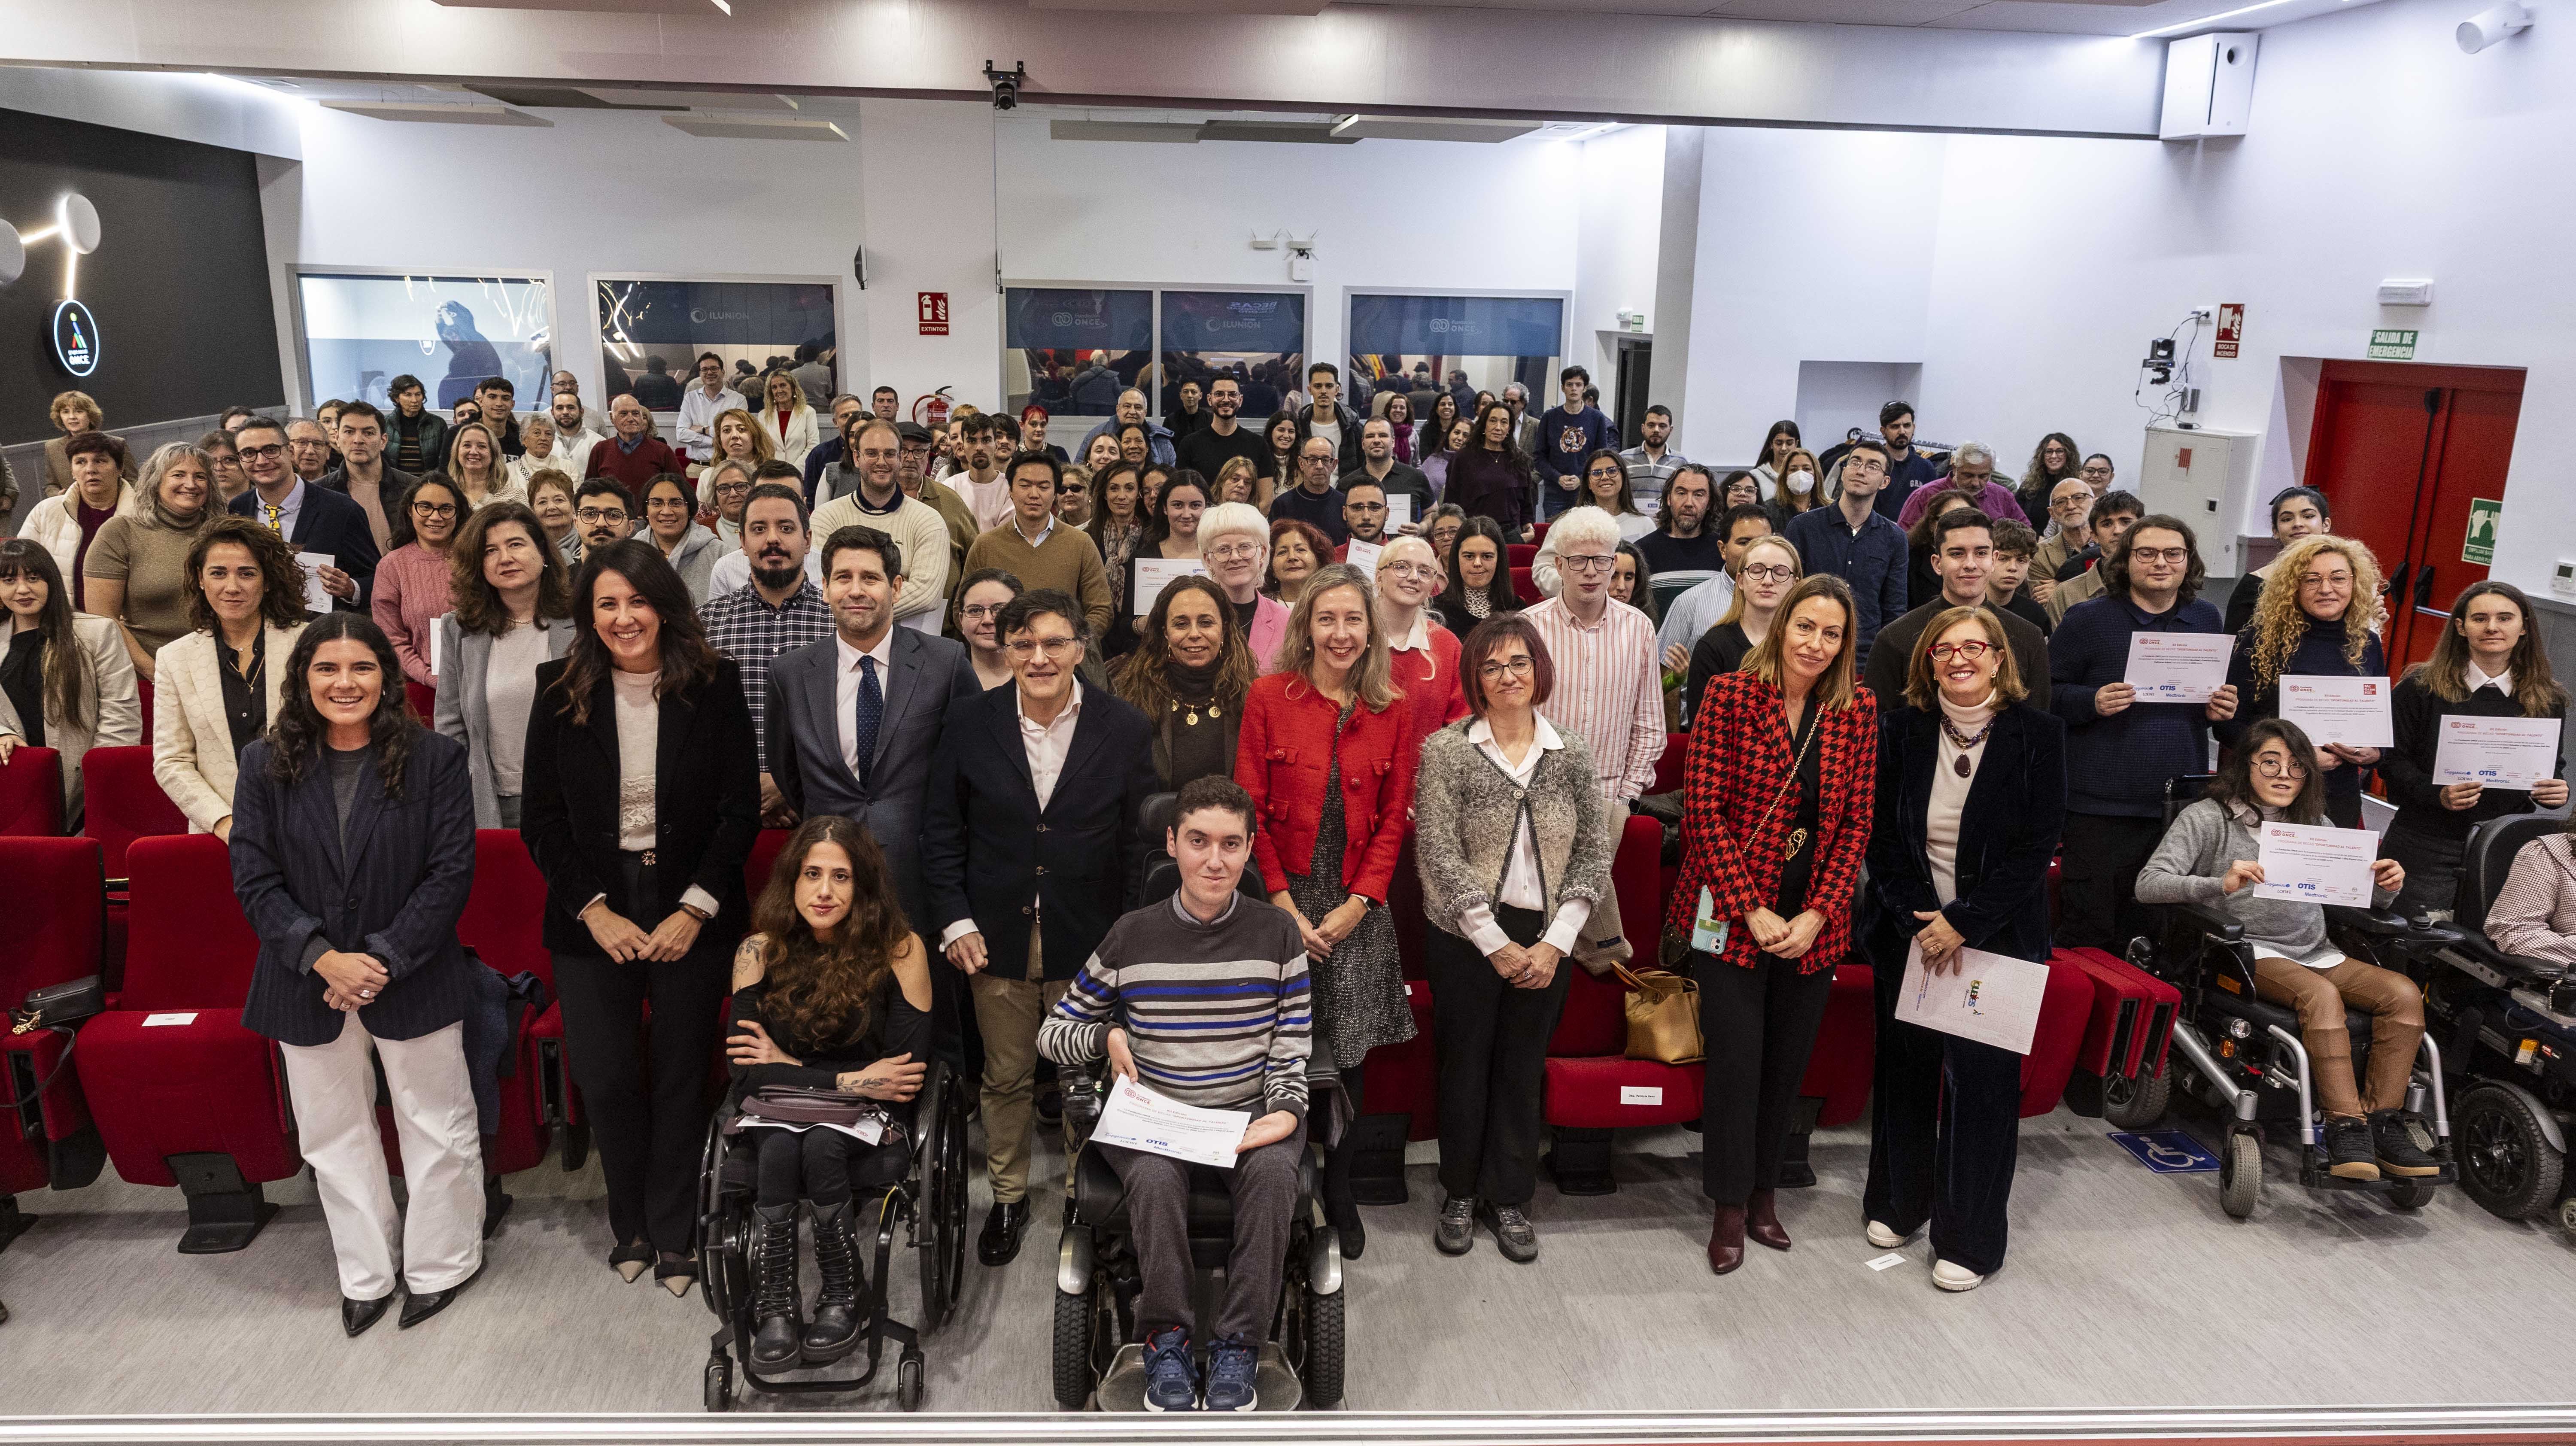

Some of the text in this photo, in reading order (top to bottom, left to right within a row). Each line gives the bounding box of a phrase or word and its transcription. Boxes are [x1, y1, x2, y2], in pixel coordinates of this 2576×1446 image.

[2375, 331, 2414, 344] SALIDA DE
[2369, 345, 2413, 358] EMERGENCIA
[69, 355, 90, 365] ONCE
[1154, 1145, 1183, 1155] Medtronic
